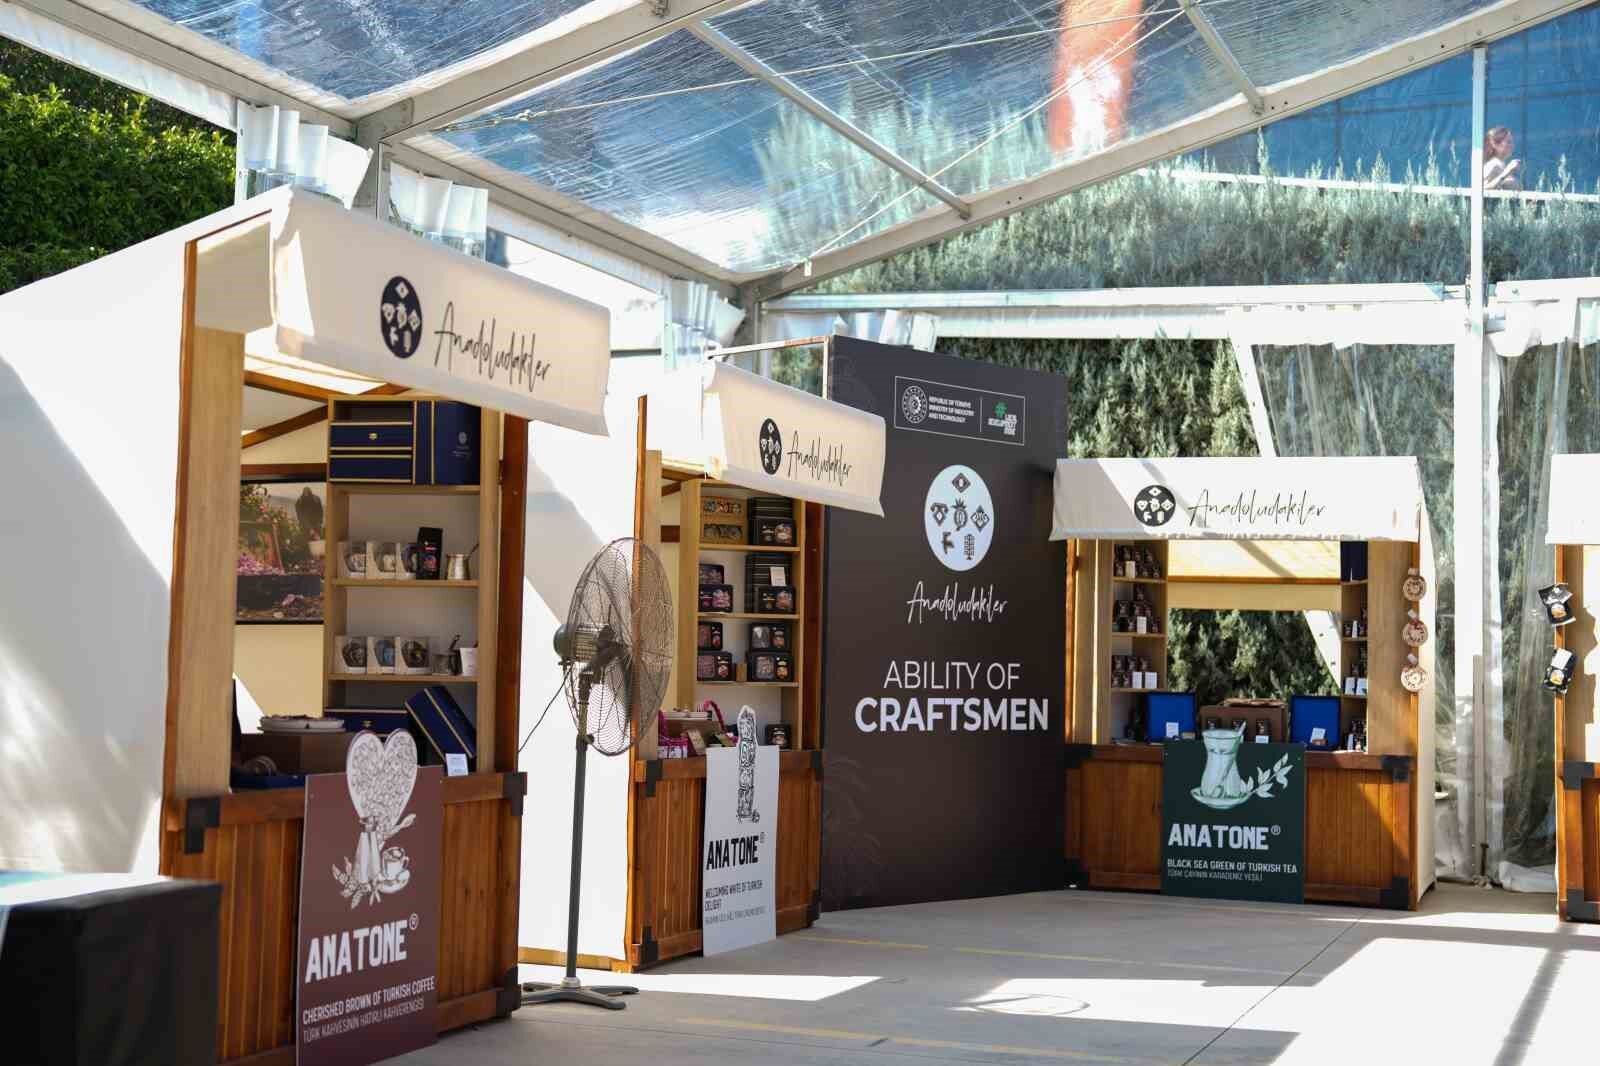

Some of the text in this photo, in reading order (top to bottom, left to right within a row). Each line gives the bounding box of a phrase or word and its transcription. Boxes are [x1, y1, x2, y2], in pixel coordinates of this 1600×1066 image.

[906, 580, 1008, 624] Anadoludakiler
[883, 660, 1020, 690] ABILITY OF
[855, 697, 1049, 733] CRAFTSMEN
[1167, 858, 1298, 873] BLACK SEA GREEN OF TURKISH TEA
[303, 975, 435, 1025] CHERISHED BROWN OF TURKISH COFFEE
